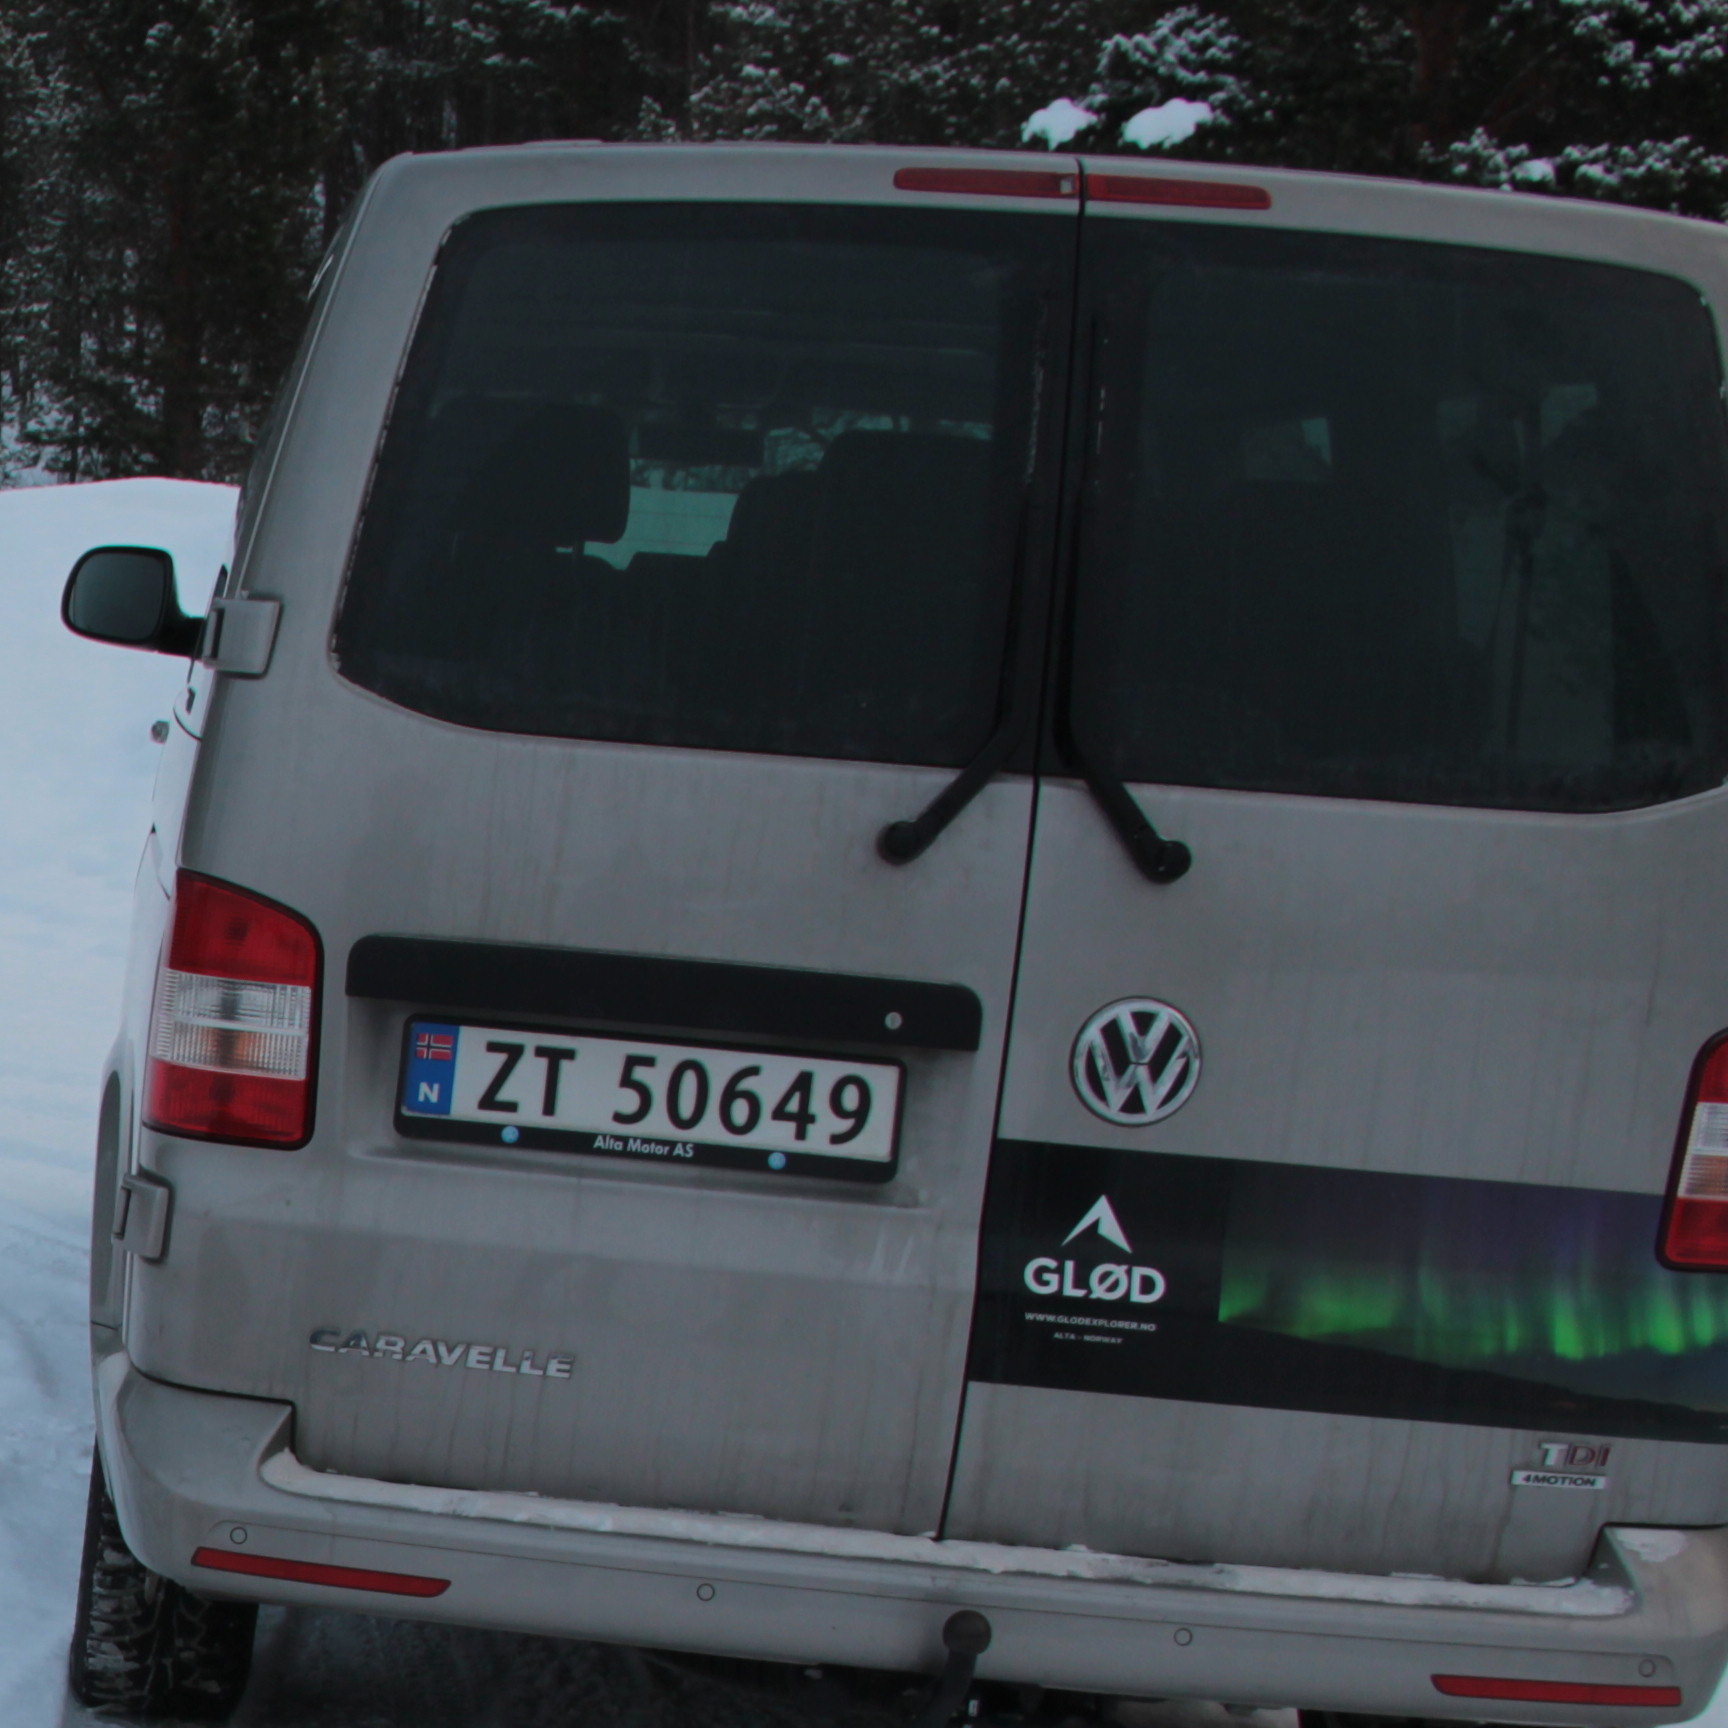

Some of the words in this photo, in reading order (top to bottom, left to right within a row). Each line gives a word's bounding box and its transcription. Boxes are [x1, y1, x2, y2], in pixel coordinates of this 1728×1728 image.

[417, 1082, 440, 1103] N
[478, 1041, 576, 1116] ZT
[612, 1054, 872, 1146] 50649
[593, 1135, 623, 1151] Alta
[627, 1138, 670, 1155] Motor
[672, 1143, 694, 1158] AS
[1024, 1257, 1166, 1304] GLØD
[1053, 1332, 1076, 1341] ALTA
[1083, 1334, 1123, 1344] NORWAY
[309, 1328, 574, 1379] CARAVELLE
[1540, 1441, 1612, 1467] TDI
[1522, 1474, 1596, 1487] 4MOTION
